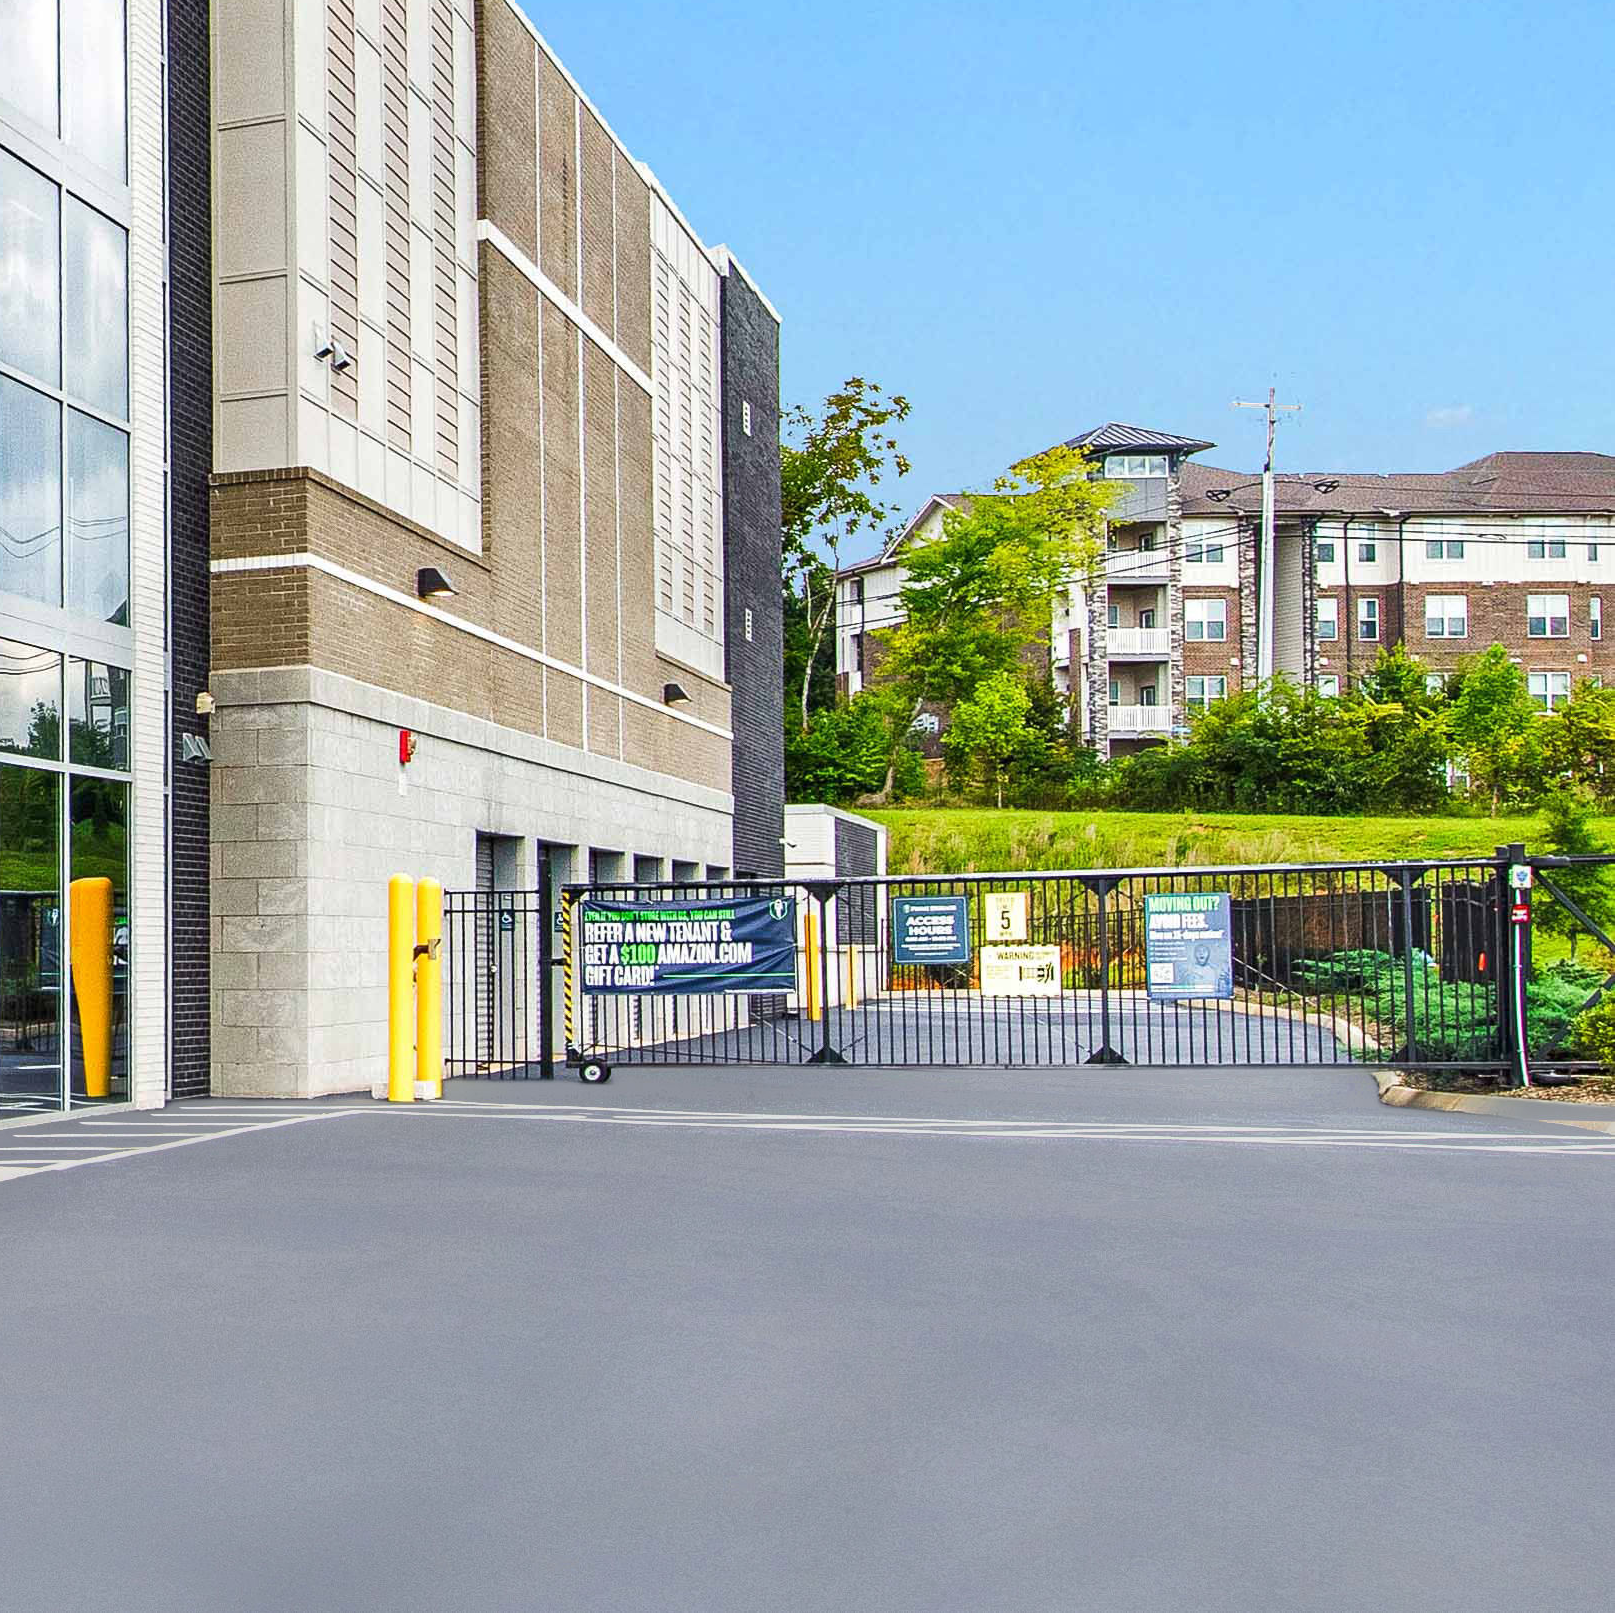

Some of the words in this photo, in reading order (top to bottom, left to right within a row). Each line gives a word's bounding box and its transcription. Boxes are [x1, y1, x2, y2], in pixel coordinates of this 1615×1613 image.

[1149, 896, 1192, 912] MOVING
[1193, 895, 1219, 911] OUT?
[718, 909, 735, 920] STILL
[906, 915, 955, 926] ACCESS
[1001, 910, 1011, 930] 5
[585, 923, 622, 943] REFER
[624, 922, 635, 942] A
[636, 922, 666, 942] NEW
[668, 921, 719, 942] TENANT
[720, 920, 733, 941] &
[908, 926, 953, 936] HOURS
[585, 944, 608, 964] GET
[609, 944, 619, 964] A
[620, 943, 656, 964] $100
[657, 942, 752, 964] AMAZON.COM
[997, 951, 1034, 961] WARNING
[585, 966, 613, 986] GIFT
